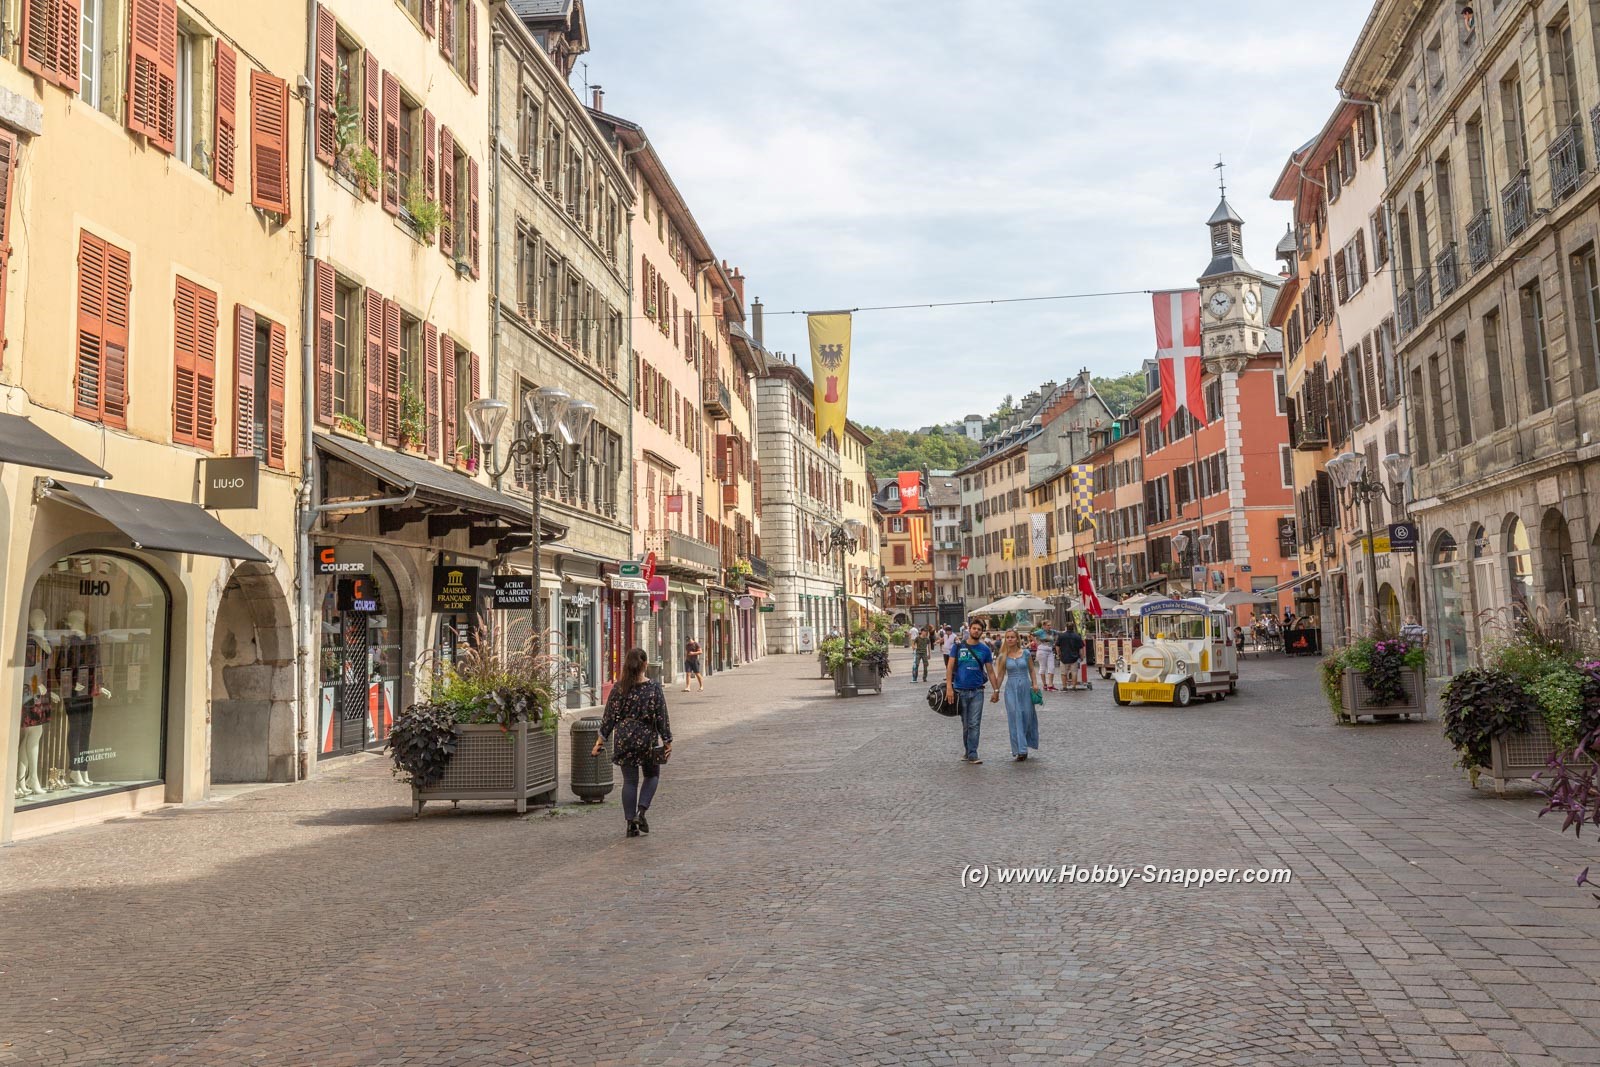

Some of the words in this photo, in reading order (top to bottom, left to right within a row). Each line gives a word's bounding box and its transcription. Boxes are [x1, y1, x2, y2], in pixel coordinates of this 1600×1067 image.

[320, 563, 365, 572] COURIR
[508, 588, 532, 596] ARGENT
[437, 595, 472, 603] FRANÇAISE
[354, 600, 377, 611] COURIR
